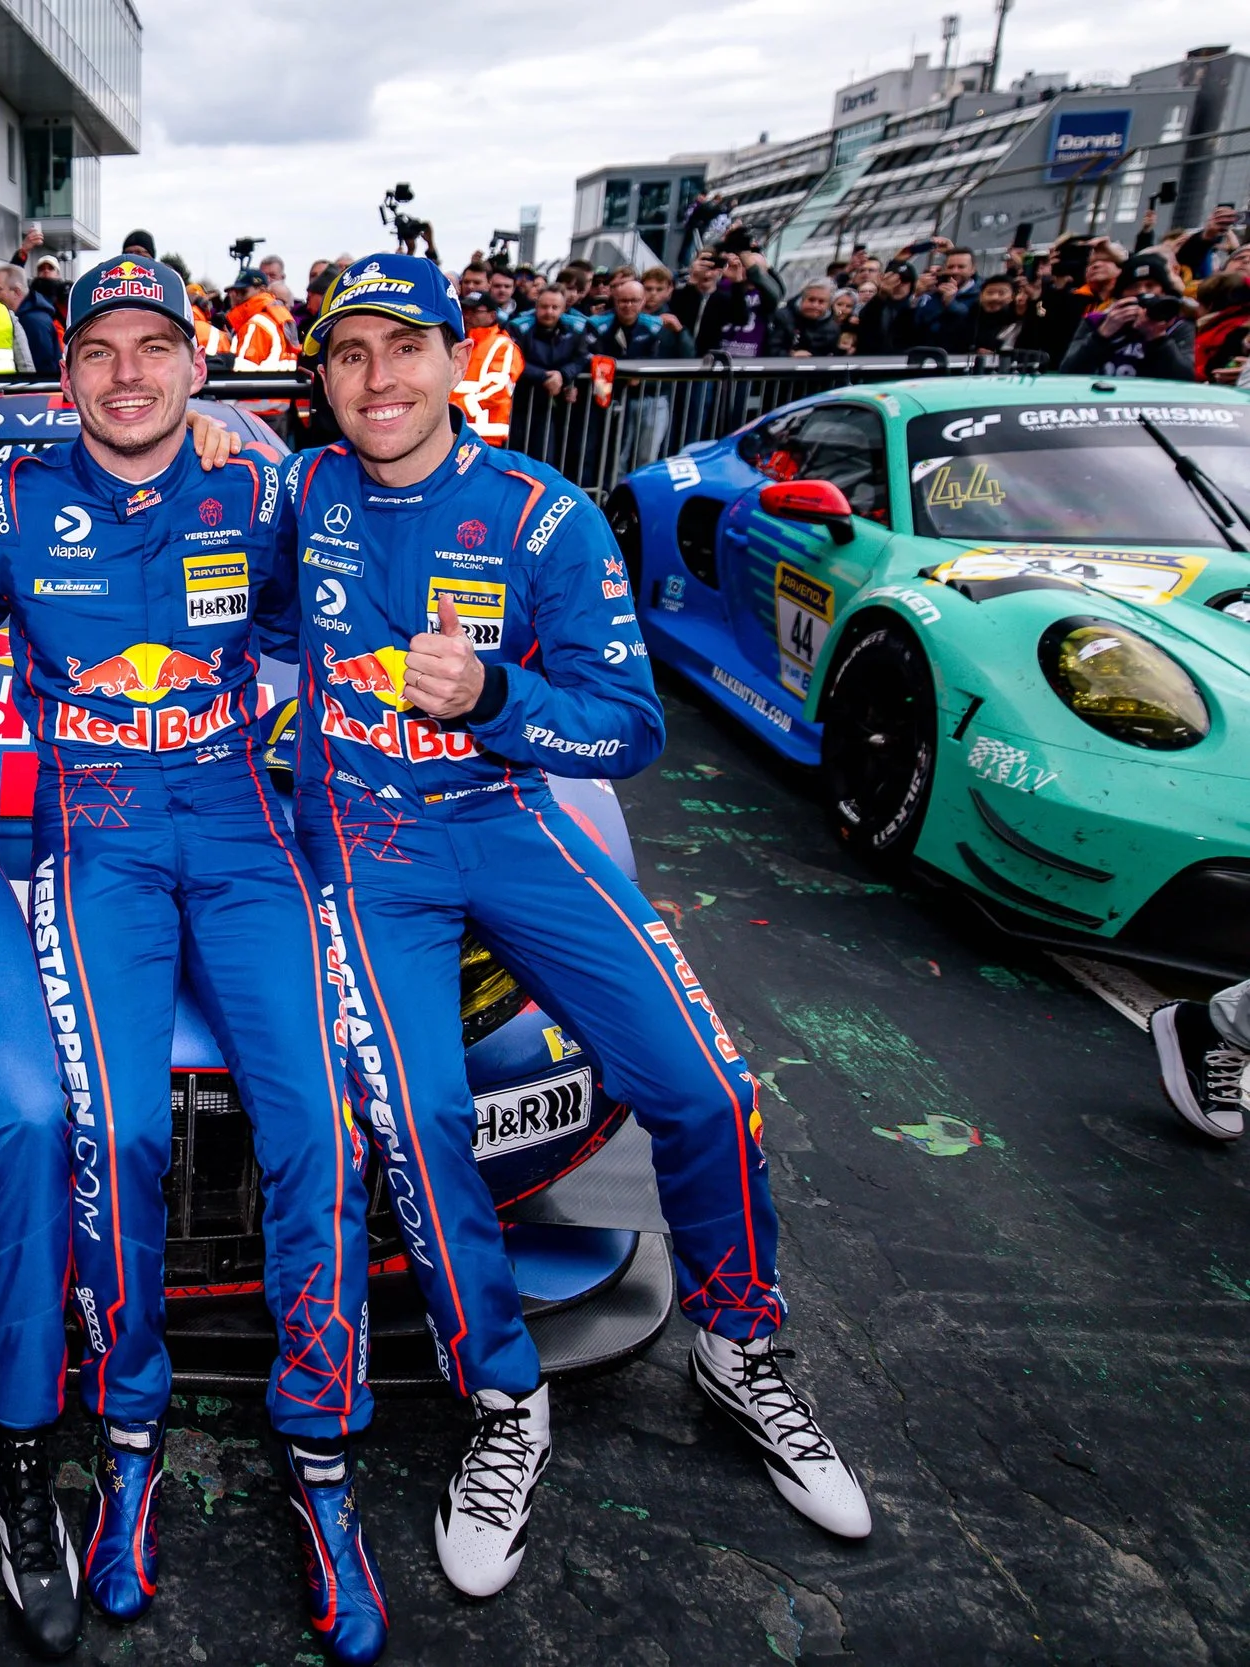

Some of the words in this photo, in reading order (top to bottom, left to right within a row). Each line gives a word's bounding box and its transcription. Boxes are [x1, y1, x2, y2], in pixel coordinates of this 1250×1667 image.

[1057, 132, 1123, 150] Dorint
[91, 281, 128, 305] Red
[129, 282, 164, 302] Bull
[1018, 407, 1099, 427] GRAN
[1103, 406, 1235, 424] TURISMO
[258, 466, 279, 525] sparco
[927, 463, 1007, 510] 44
[386, 494, 423, 504] AMG
[184, 529, 243, 541] VERSTAPPEN
[526, 494, 577, 556] sparco
[48, 545, 97, 560] viaplay
[201, 537, 230, 546] RACING
[325, 540, 360, 551] AMG
[320, 561, 359, 572] MICHELIN
[434, 550, 504, 566] VERSTAPPEN
[452, 561, 485, 571] RACING
[192, 566, 242, 578] RAVENOL
[54, 582, 103, 591] MICHELIN
[784, 575, 825, 606] RAVENOL
[190, 596, 228, 619] H&R
[312, 614, 353, 635] viaplay
[790, 610, 814, 662] 44
[712, 666, 793, 733] FALKENTYRE.COM
[54, 701, 151, 752] Red
[156, 691, 236, 753] Bull
[322, 690, 403, 758] Red
[529, 726, 598, 758] Player
[643, 920, 701, 989] Bull
[685, 988, 740, 1064] Red
[473, 1095, 544, 1149] H&R
[76, 1286, 106, 1354] sparco
[357, 1300, 370, 1385] sparco
